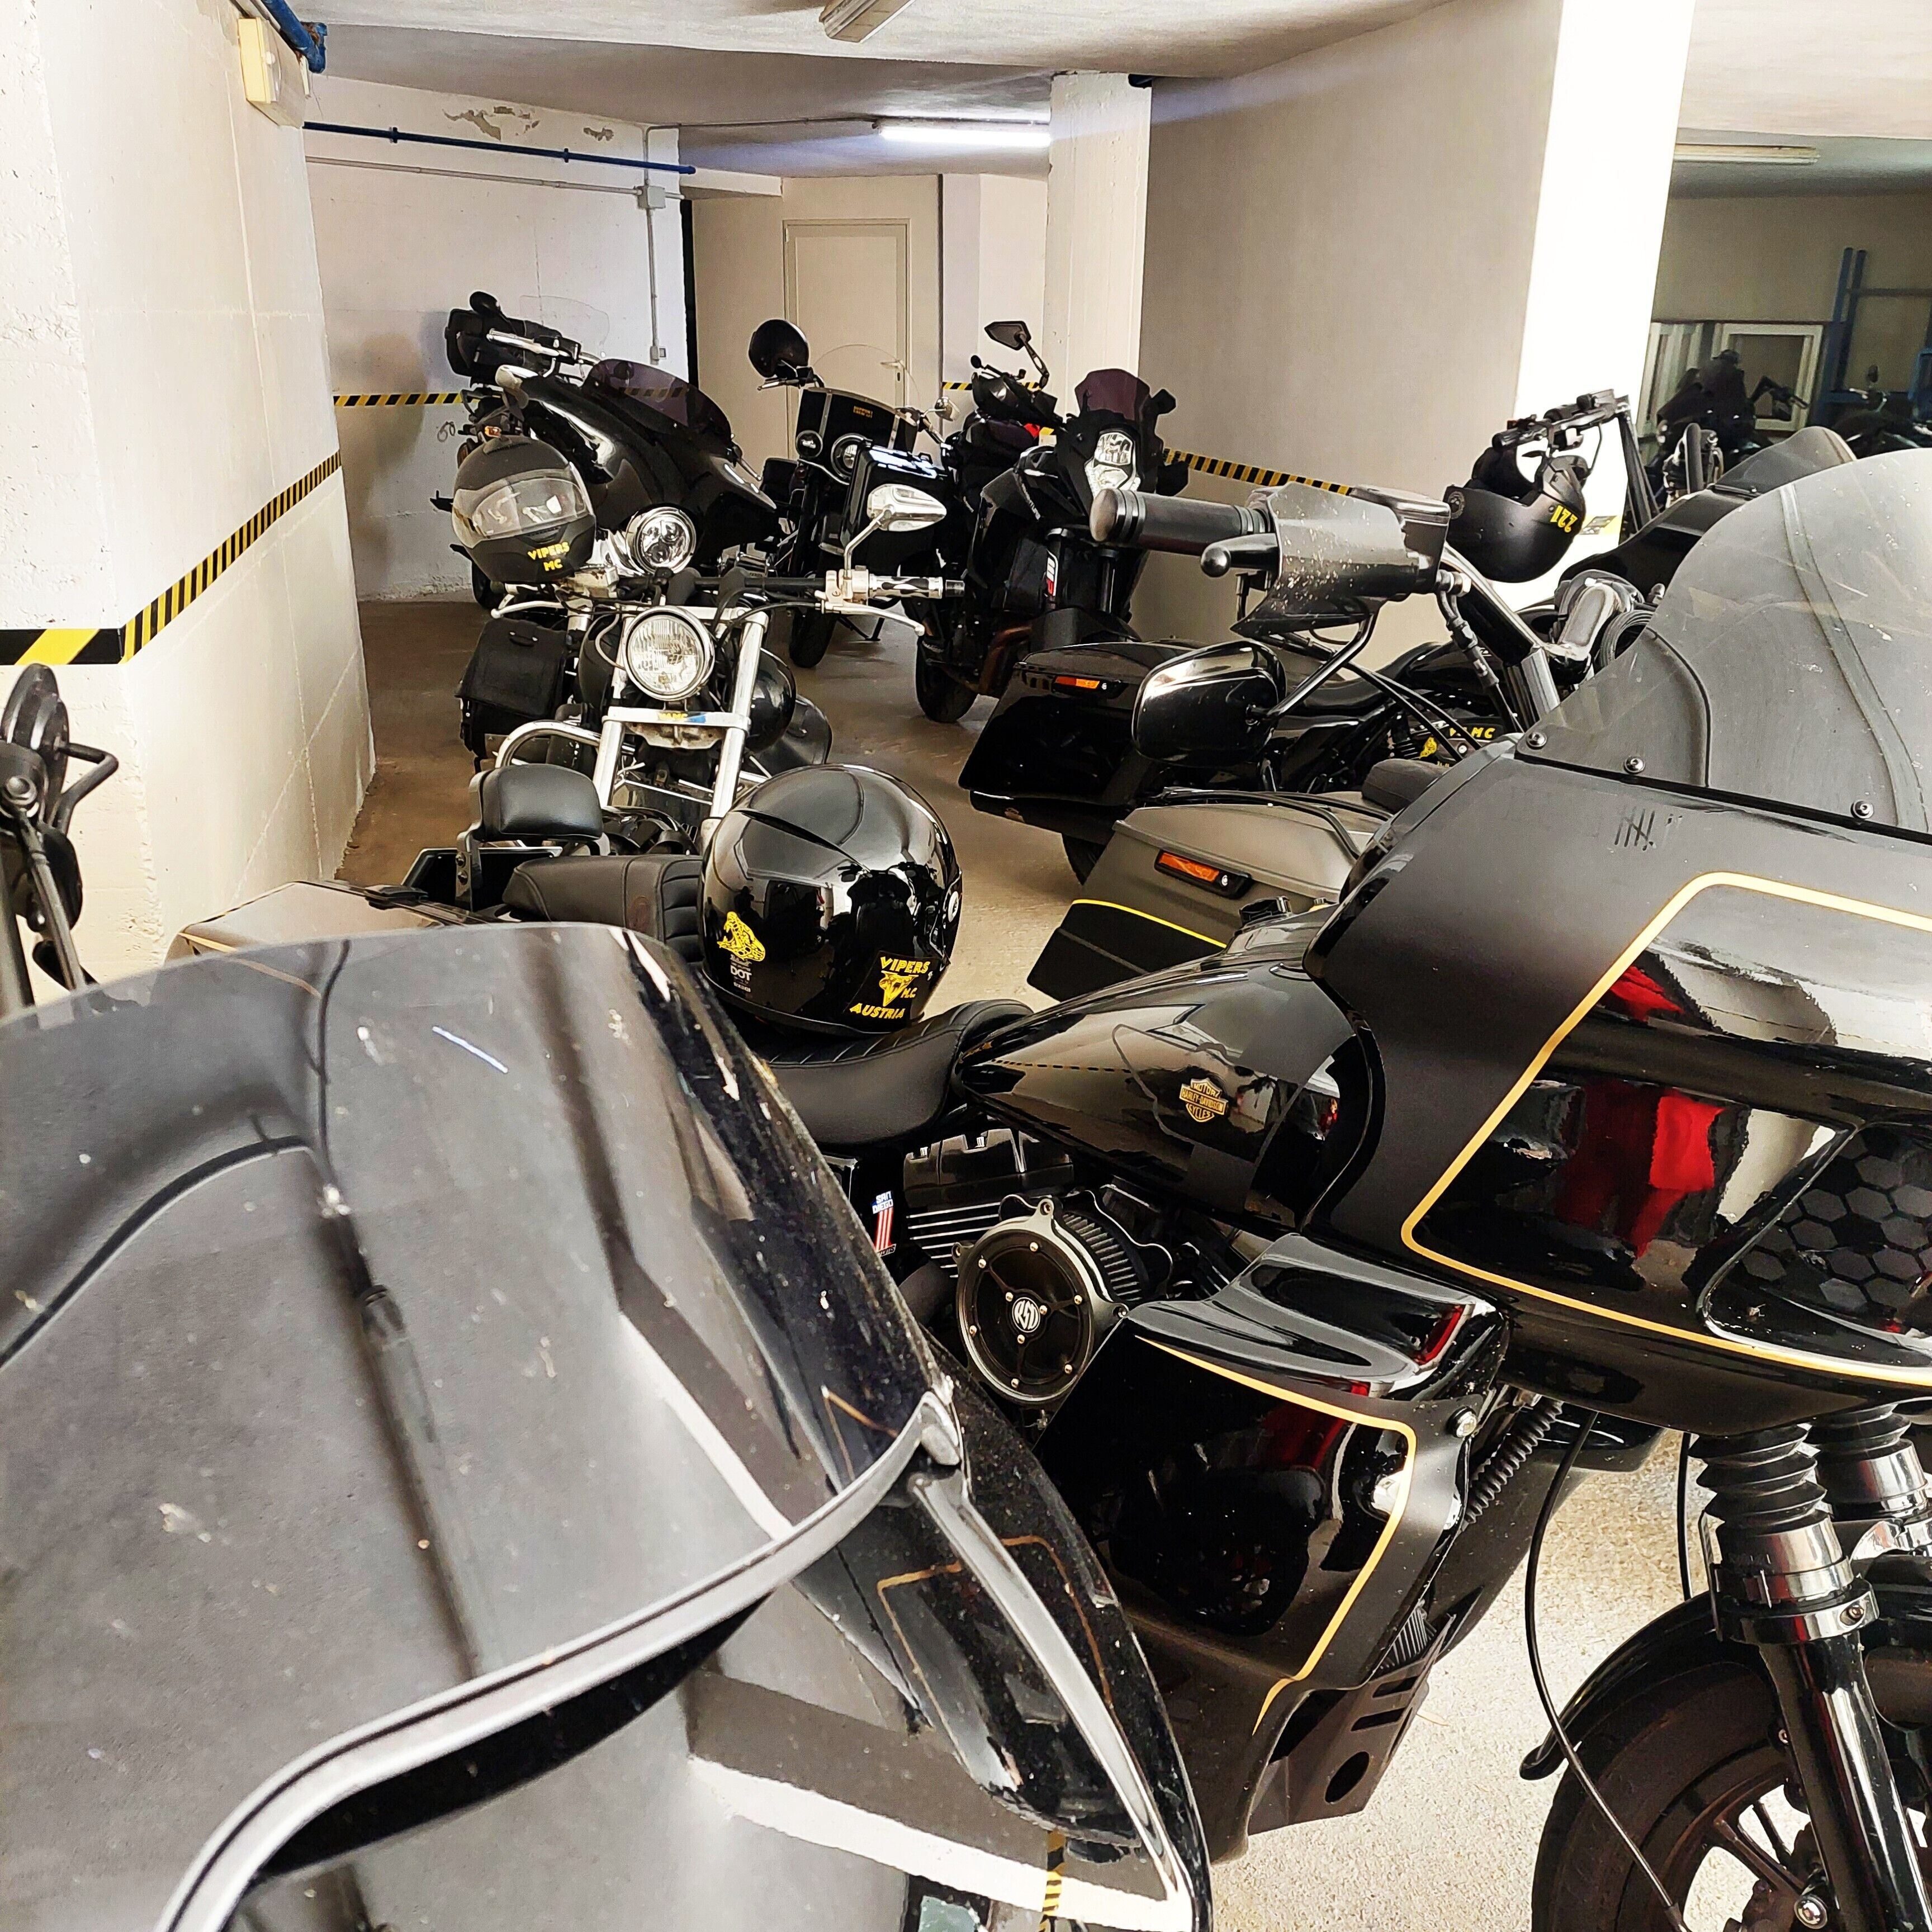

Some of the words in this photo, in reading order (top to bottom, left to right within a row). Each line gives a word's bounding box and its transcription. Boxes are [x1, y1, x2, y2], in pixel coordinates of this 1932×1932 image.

[1550, 505, 1578, 533] 221
[527, 542, 570, 560] VIPERS
[543, 558, 563, 571] MC
[730, 965, 752, 981] DOT
[880, 956, 931, 974] VIPERS
[849, 1002, 906, 1019] AUSTRIA
[1193, 1082, 1216, 1097] MOTOR
[1182, 1088, 1224, 1112] HARLEY-DAVIDSON
[1188, 1104, 1211, 1119] CYCLES
[875, 1190, 892, 1204] SAN
[872, 1199, 894, 1215] DIEGO
